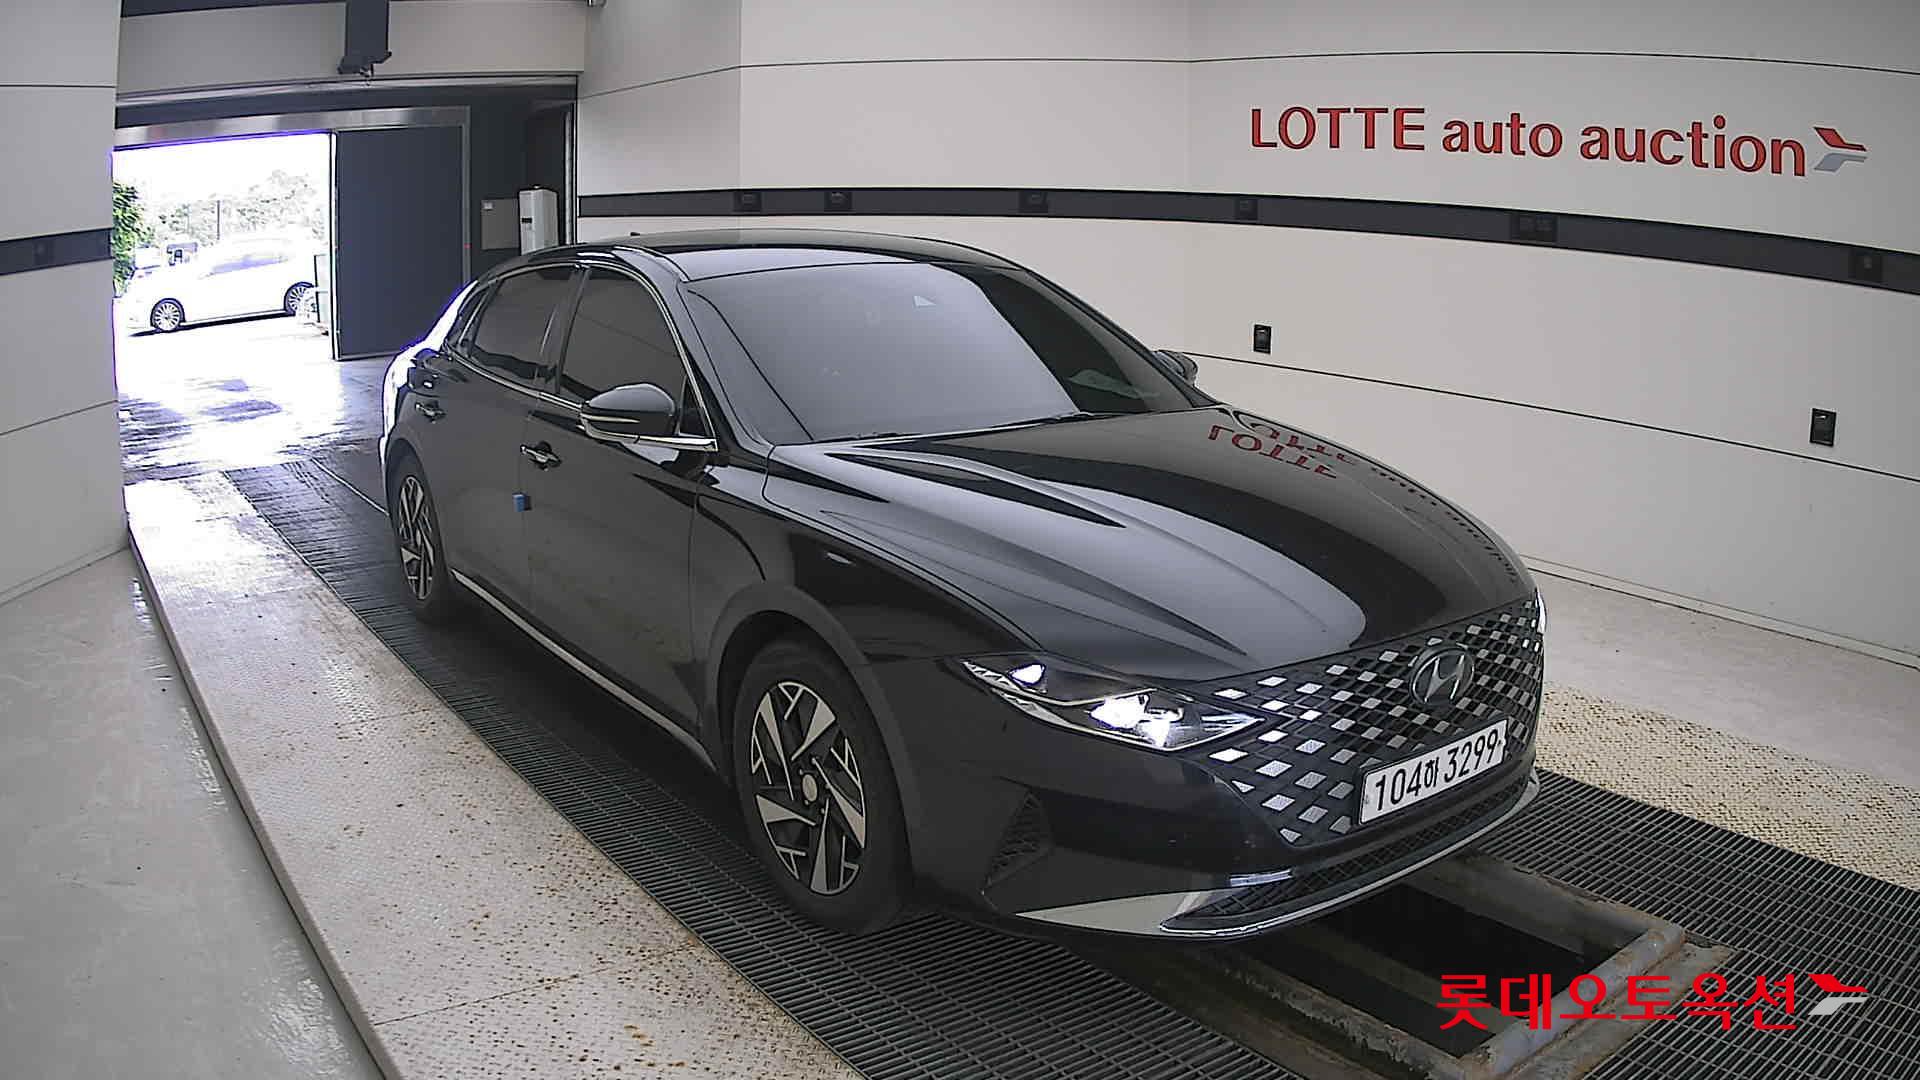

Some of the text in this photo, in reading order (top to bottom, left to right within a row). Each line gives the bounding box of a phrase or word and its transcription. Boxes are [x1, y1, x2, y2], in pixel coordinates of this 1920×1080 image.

[1251, 107, 1806, 177] LOTTE auto auction
[1376, 729, 1498, 811] 104하 3299
